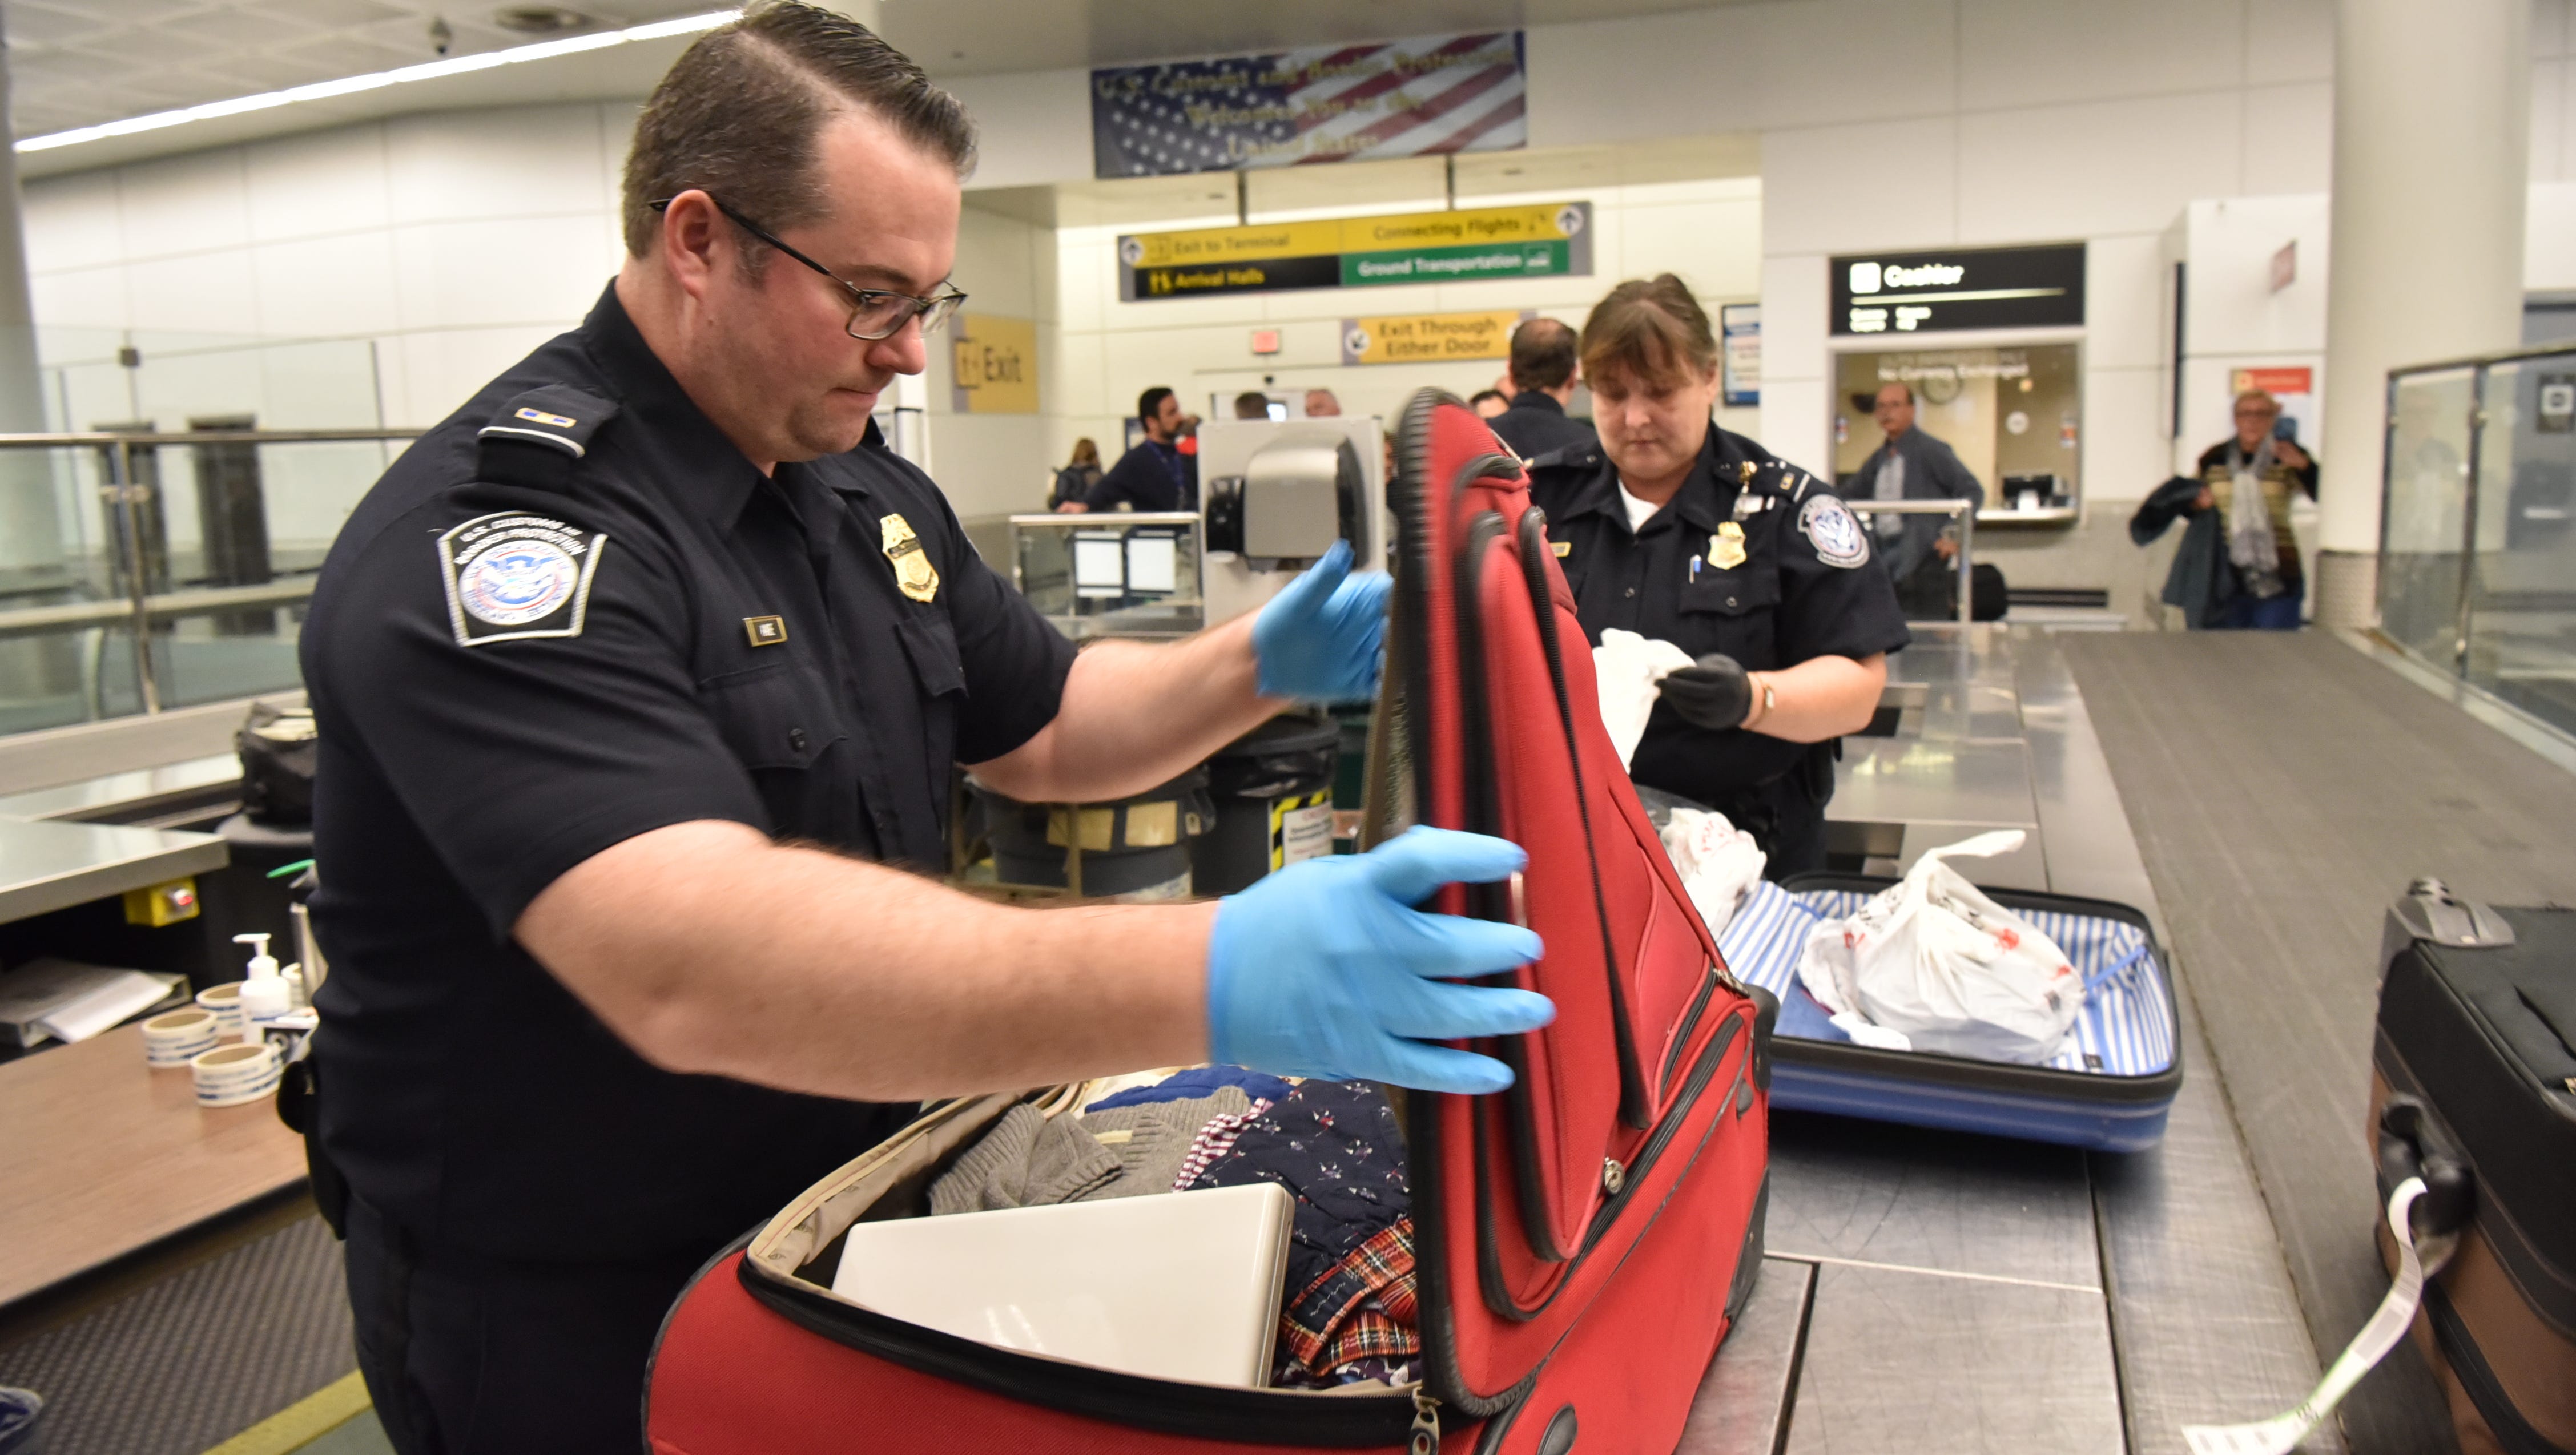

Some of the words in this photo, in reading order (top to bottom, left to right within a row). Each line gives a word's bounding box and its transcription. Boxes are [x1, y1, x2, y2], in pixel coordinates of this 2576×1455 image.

[1373, 223, 1463, 241] Connecting
[1467, 218, 1521, 237] Flights
[1174, 239, 1201, 255] Exit
[1205, 239, 1221, 252] to
[1225, 233, 1290, 249] Terminal
[1358, 259, 1413, 277] Ground
[1415, 253, 1522, 275] Transportation
[1884, 263, 1965, 288] Cashier
[1174, 270, 1225, 288] Arrival
[1227, 267, 1266, 285] Halls
[1379, 321, 1413, 338] Exit
[1419, 317, 1498, 336] Through
[1386, 341, 1439, 357] Either
[1445, 337, 1490, 354] Door
[983, 345, 1023, 382] Exit
